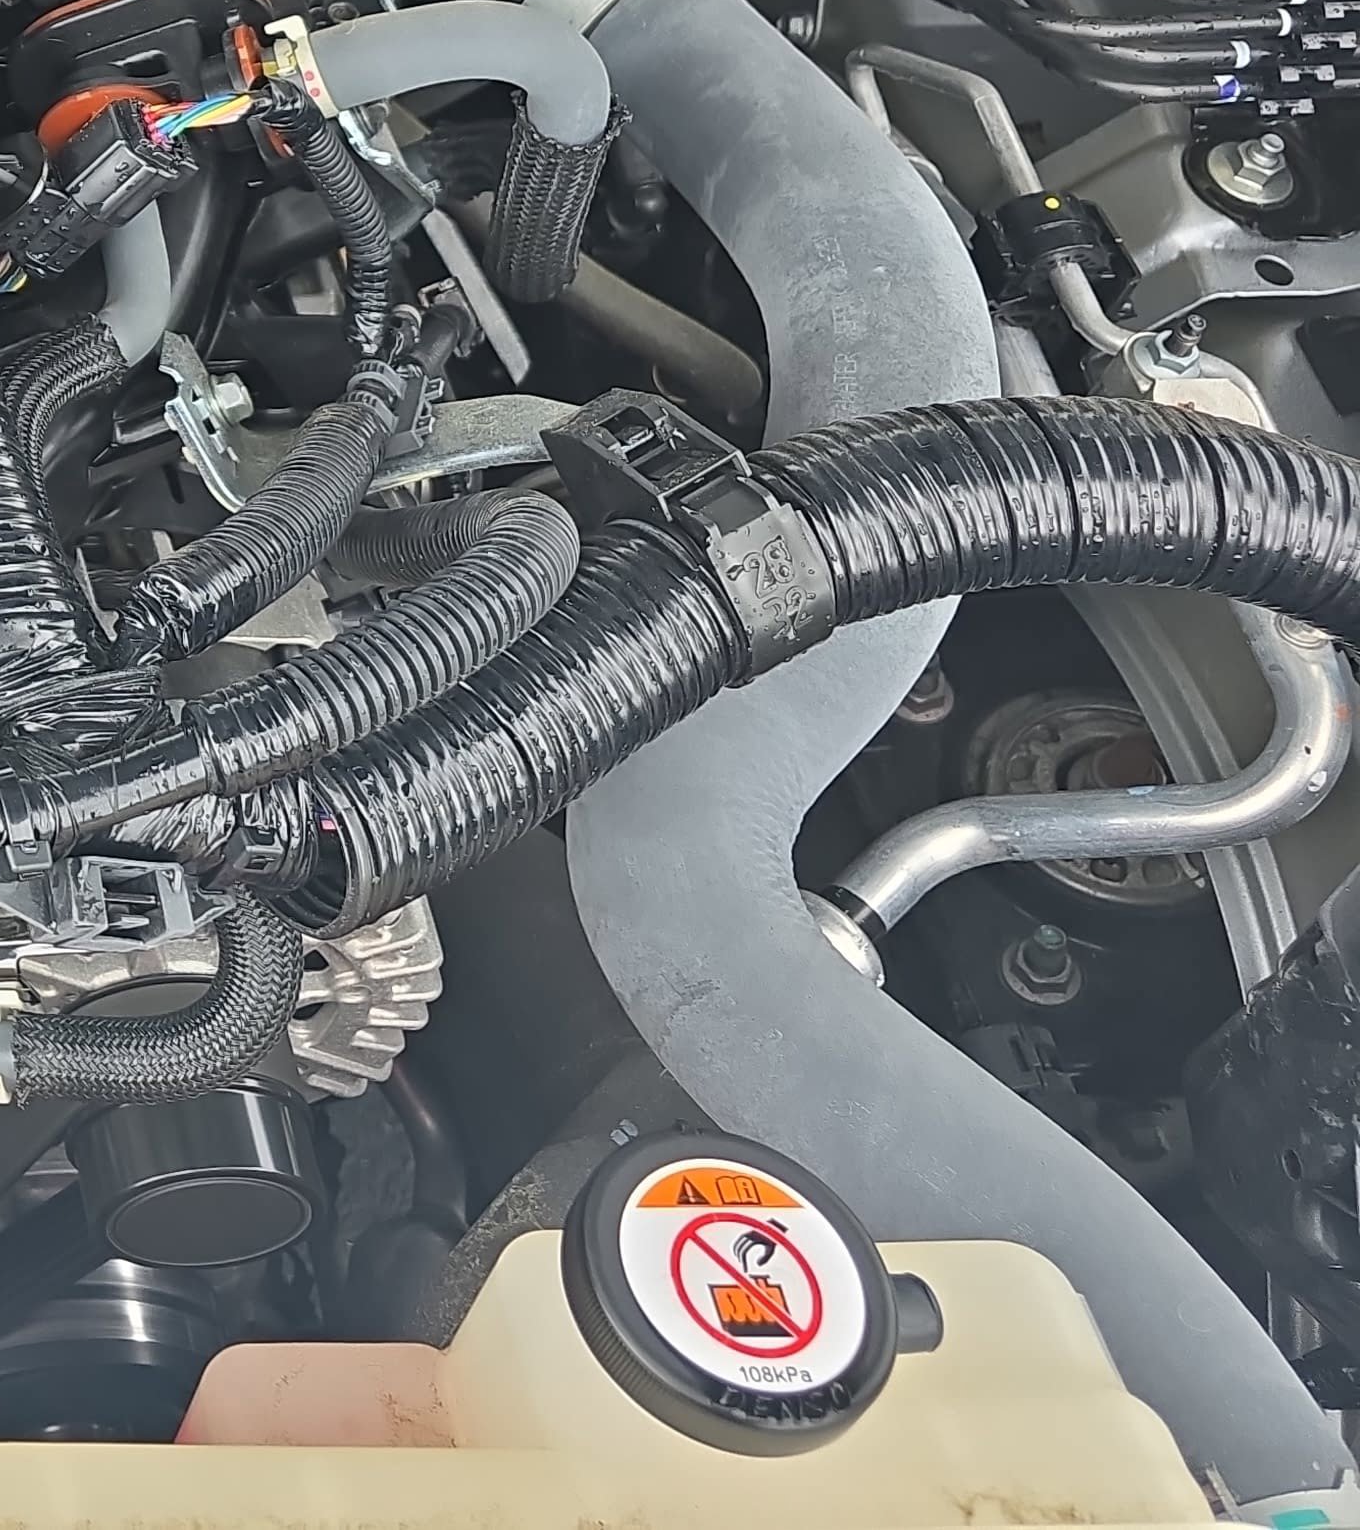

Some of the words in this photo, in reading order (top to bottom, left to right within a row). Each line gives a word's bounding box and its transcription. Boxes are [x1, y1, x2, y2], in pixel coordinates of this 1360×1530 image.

[743, 538, 795, 599] 28
[739, 1365, 814, 1385] 108kPa
[711, 1380, 853, 1421] DENSO
